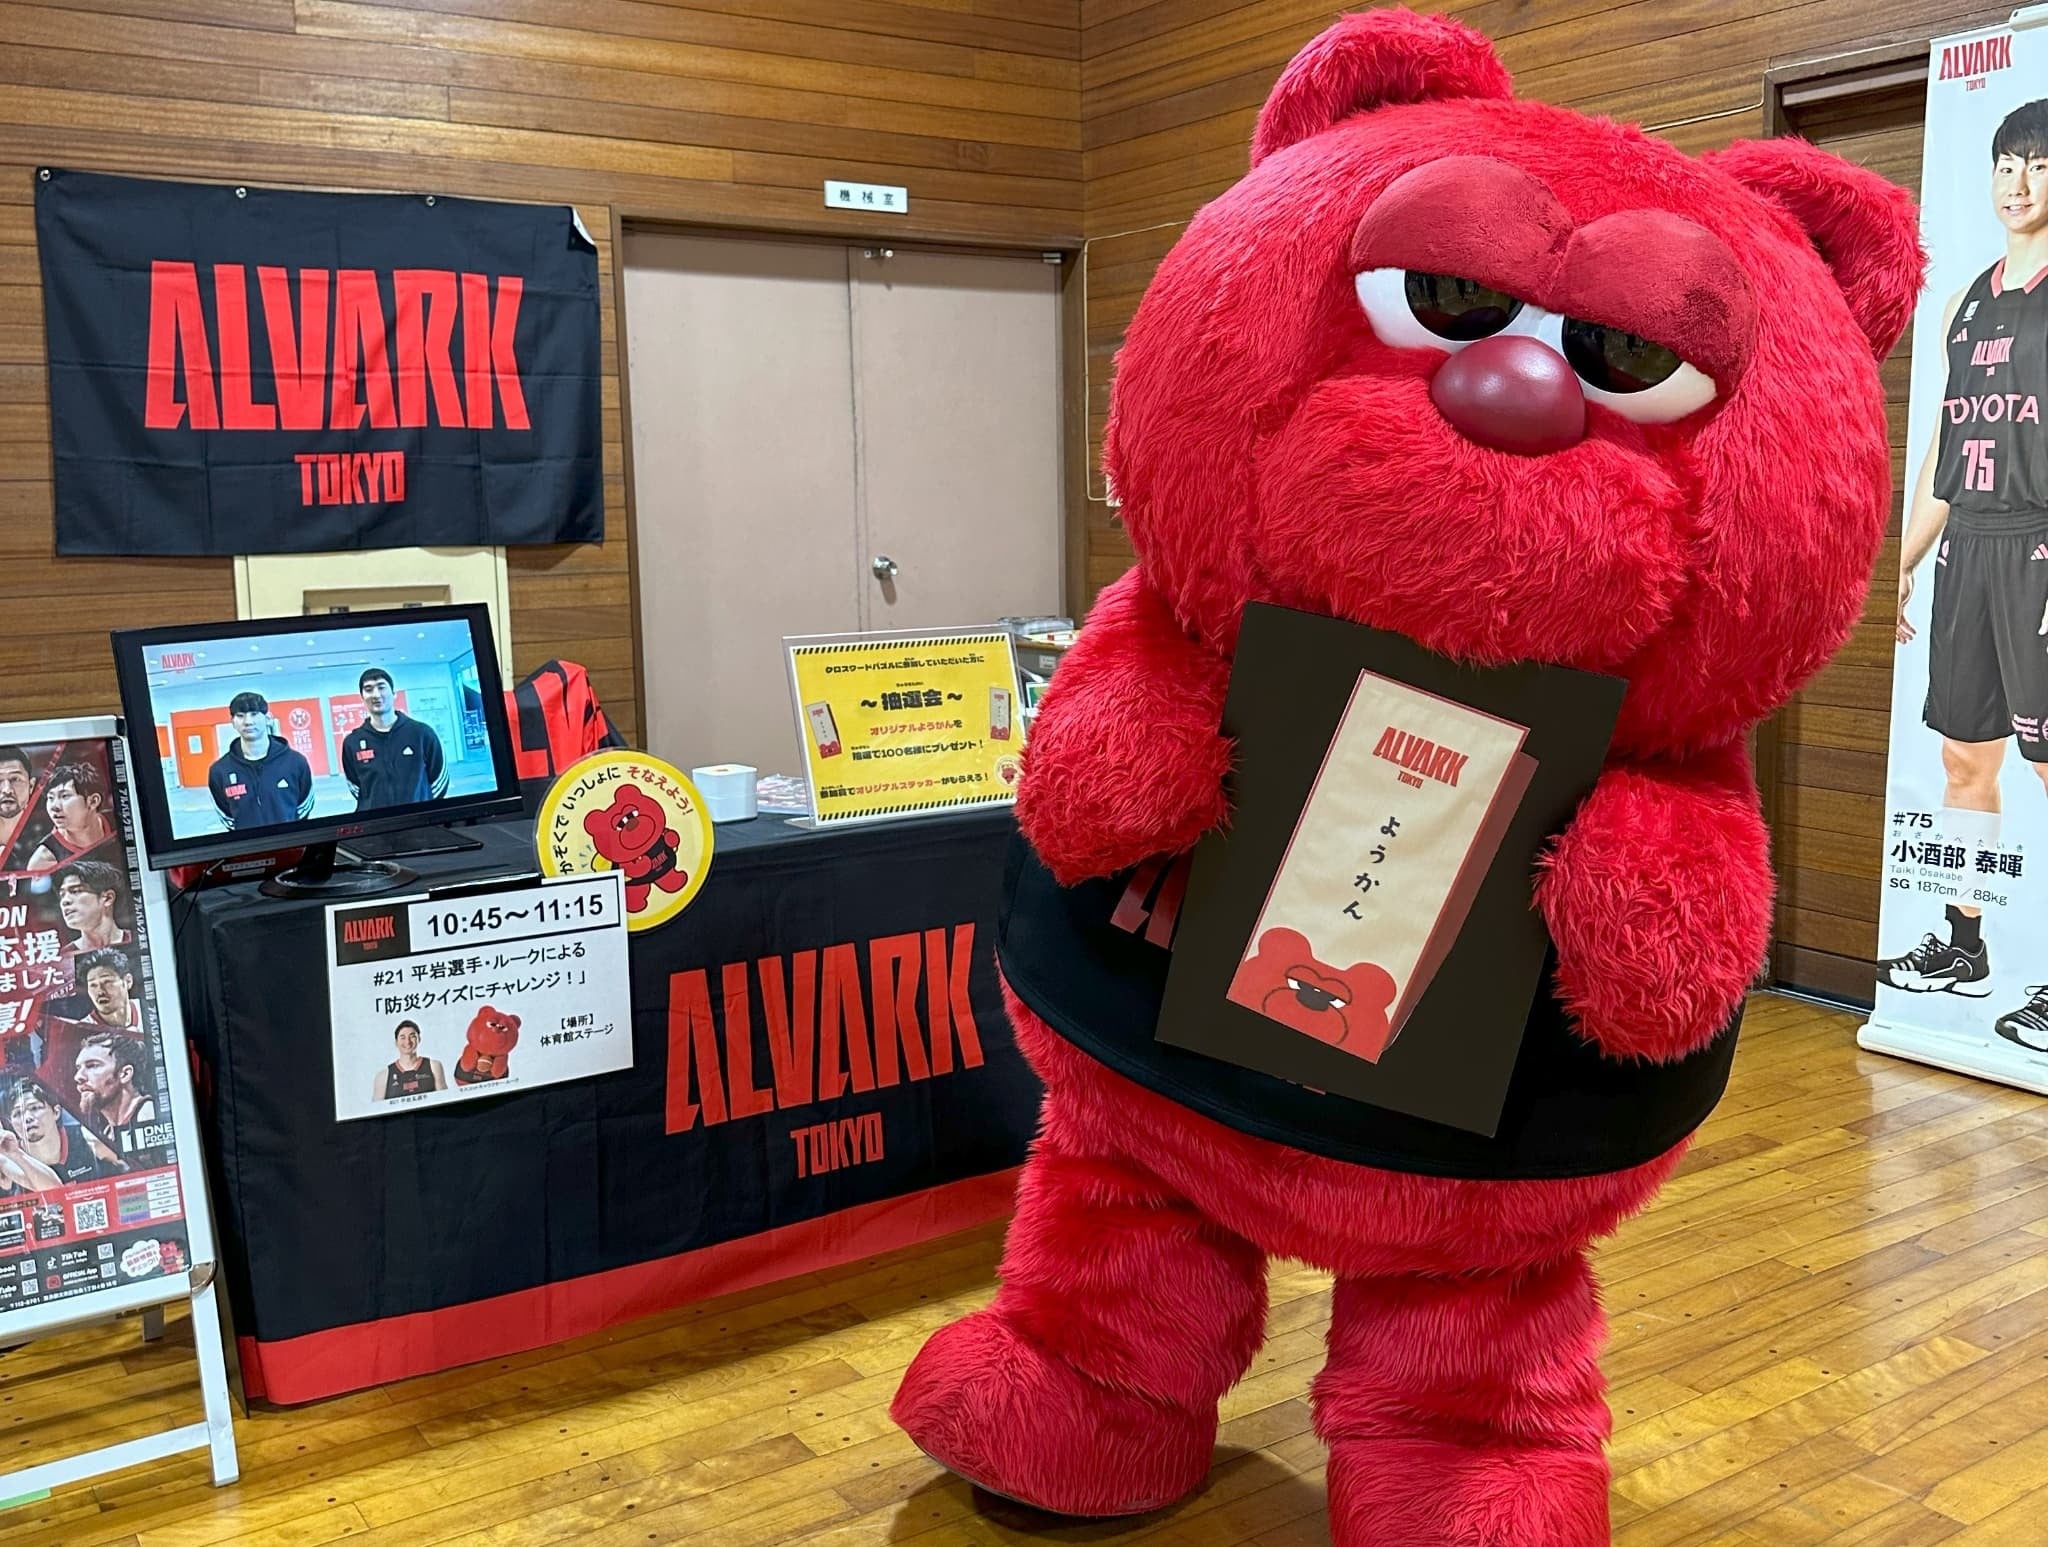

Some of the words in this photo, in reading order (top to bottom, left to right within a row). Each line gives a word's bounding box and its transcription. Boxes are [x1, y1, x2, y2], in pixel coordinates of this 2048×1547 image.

[1938, 35, 2012, 80] ALVARK
[1966, 78, 1986, 91] TOKYO
[145, 260, 531, 430] ALVARK
[1971, 336, 2014, 366] ALVARK
[1943, 393, 2039, 425] TOYOTA
[294, 451, 405, 506] TOKYO
[1962, 440, 1996, 491] 75
[870, 719, 962, 736] オリジナルようかんを
[1372, 726, 1469, 787] ALVARK
[1397, 770, 1424, 789] TOKYO
[1893, 811, 1933, 828] #75
[1343, 816, 1400, 921] ようかん
[1890, 839, 1966, 869] 小酒部
[1975, 850, 2024, 879] 泰暉
[1890, 864, 1915, 875] Taiki
[1889, 877, 1910, 889] SG
[344, 916, 395, 943] ALVARK
[373, 968, 404, 986] #21
[411, 941, 586, 981] 平岩選手・ルークによる
[375, 970, 587, 1015] 「防災クイズにチャレンジ！」
[540, 1023, 614, 1048] 体育館ステージ
[561, 1012, 594, 1030] 【場所】
[665, 922, 984, 1135] ALVARK
[144, 1122, 173, 1137] ONE
[790, 1112, 884, 1179] TOKYO
